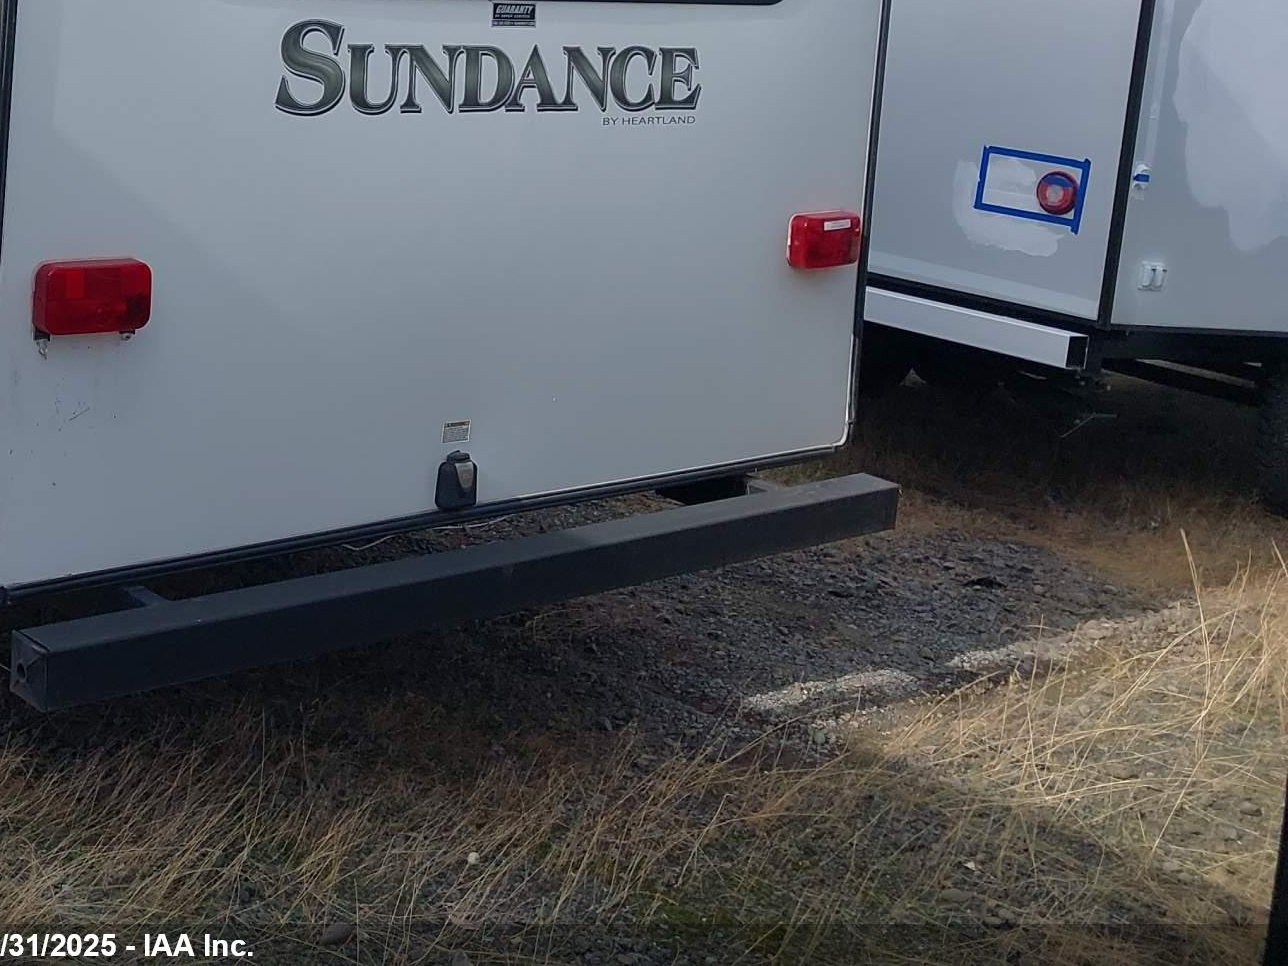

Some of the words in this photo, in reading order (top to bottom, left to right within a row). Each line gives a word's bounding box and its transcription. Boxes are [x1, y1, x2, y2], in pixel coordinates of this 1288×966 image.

[495, 4, 535, 14] GUARANTY
[274, 18, 703, 116] SUNDANCE
[602, 116, 619, 126] BY
[621, 115, 696, 126] HEARTLAND
